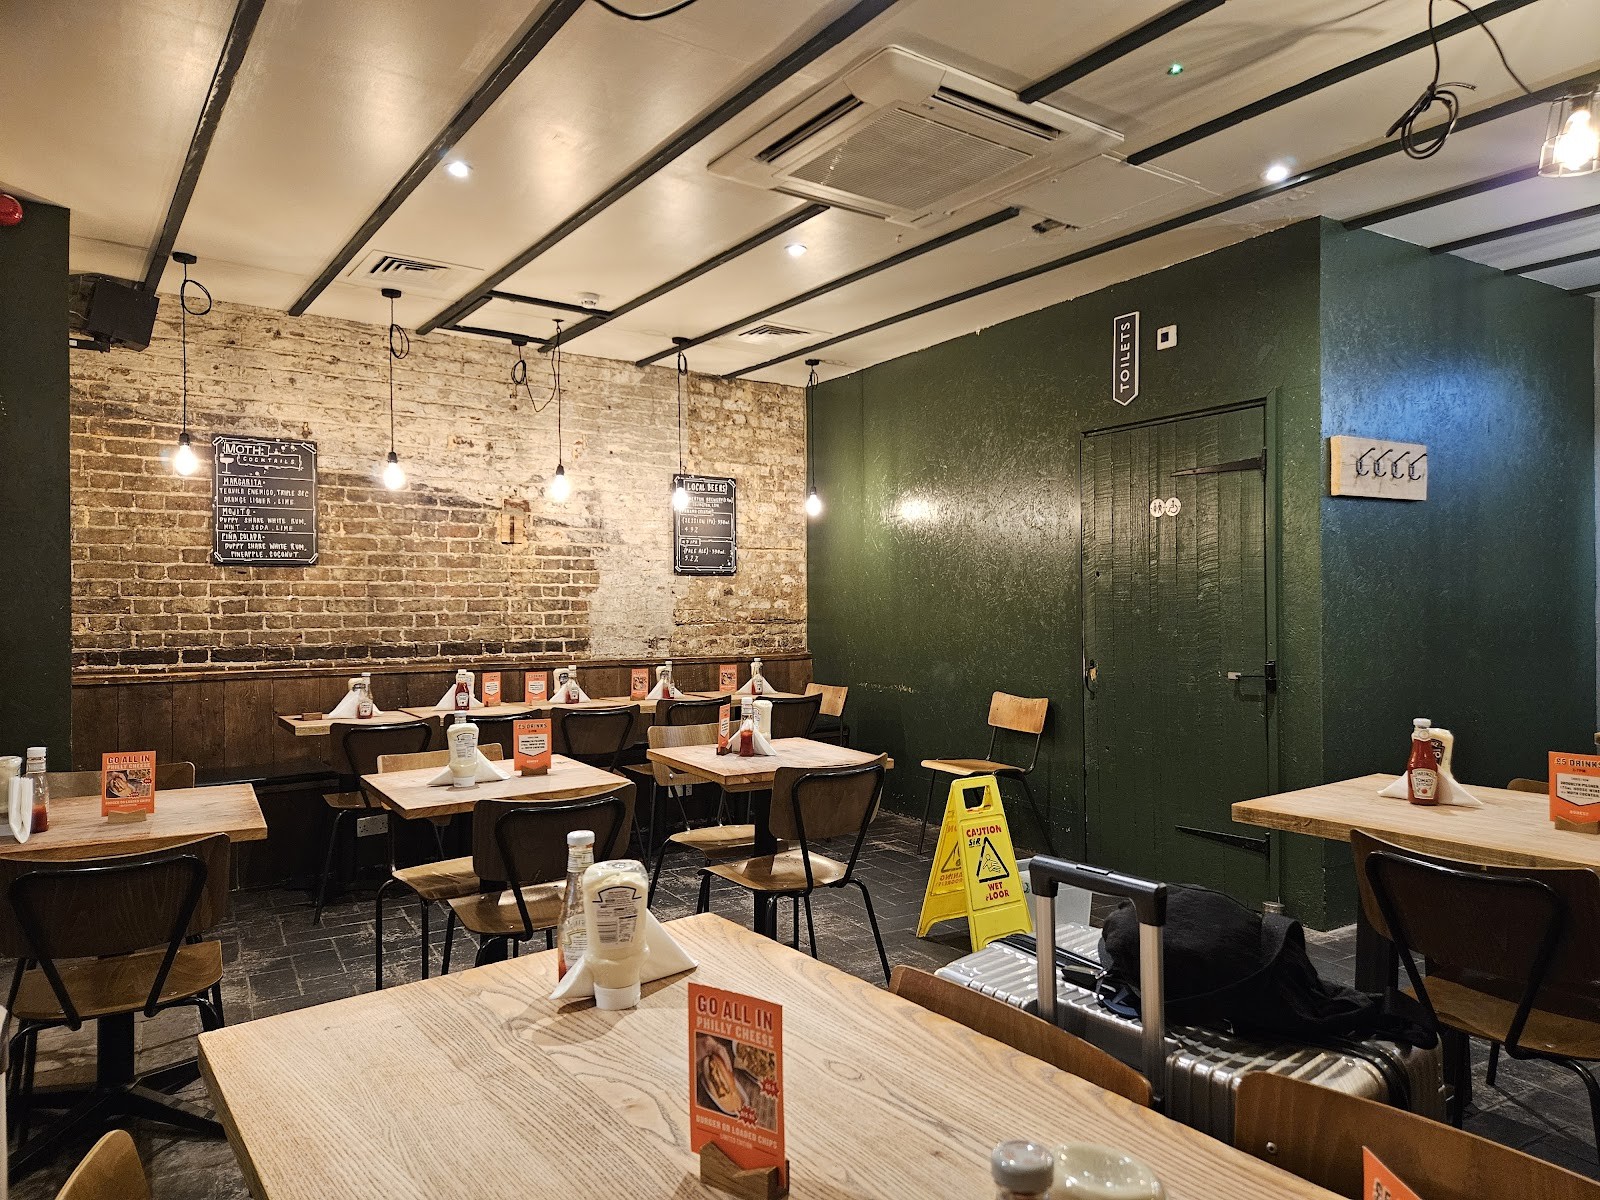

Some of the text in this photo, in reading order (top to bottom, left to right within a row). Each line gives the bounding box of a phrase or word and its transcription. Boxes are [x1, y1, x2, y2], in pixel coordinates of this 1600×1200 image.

[1120, 321, 1131, 394] TOILETS
[242, 456, 296, 465] COCKTAILS
[687, 482, 726, 493] LOCAL BEERS
[297, 490, 310, 498] SEC
[223, 496, 247, 504] ORANGE
[219, 516, 239, 524] PUPPY
[223, 523, 240, 531] MINT
[224, 542, 244, 550] PUPPY
[269, 543, 288, 551] WHITE
[230, 551, 264, 559] PINEAPPLE
[107, 756, 120, 764] GO
[121, 755, 138, 764] ALL
[1555, 757, 1567, 766] £5
[966, 824, 1002, 838] CAUTION
[987, 881, 1003, 891] WET
[696, 993, 773, 1033] GO ALL IN
[696, 1015, 775, 1049] PHILLY CHEESE
